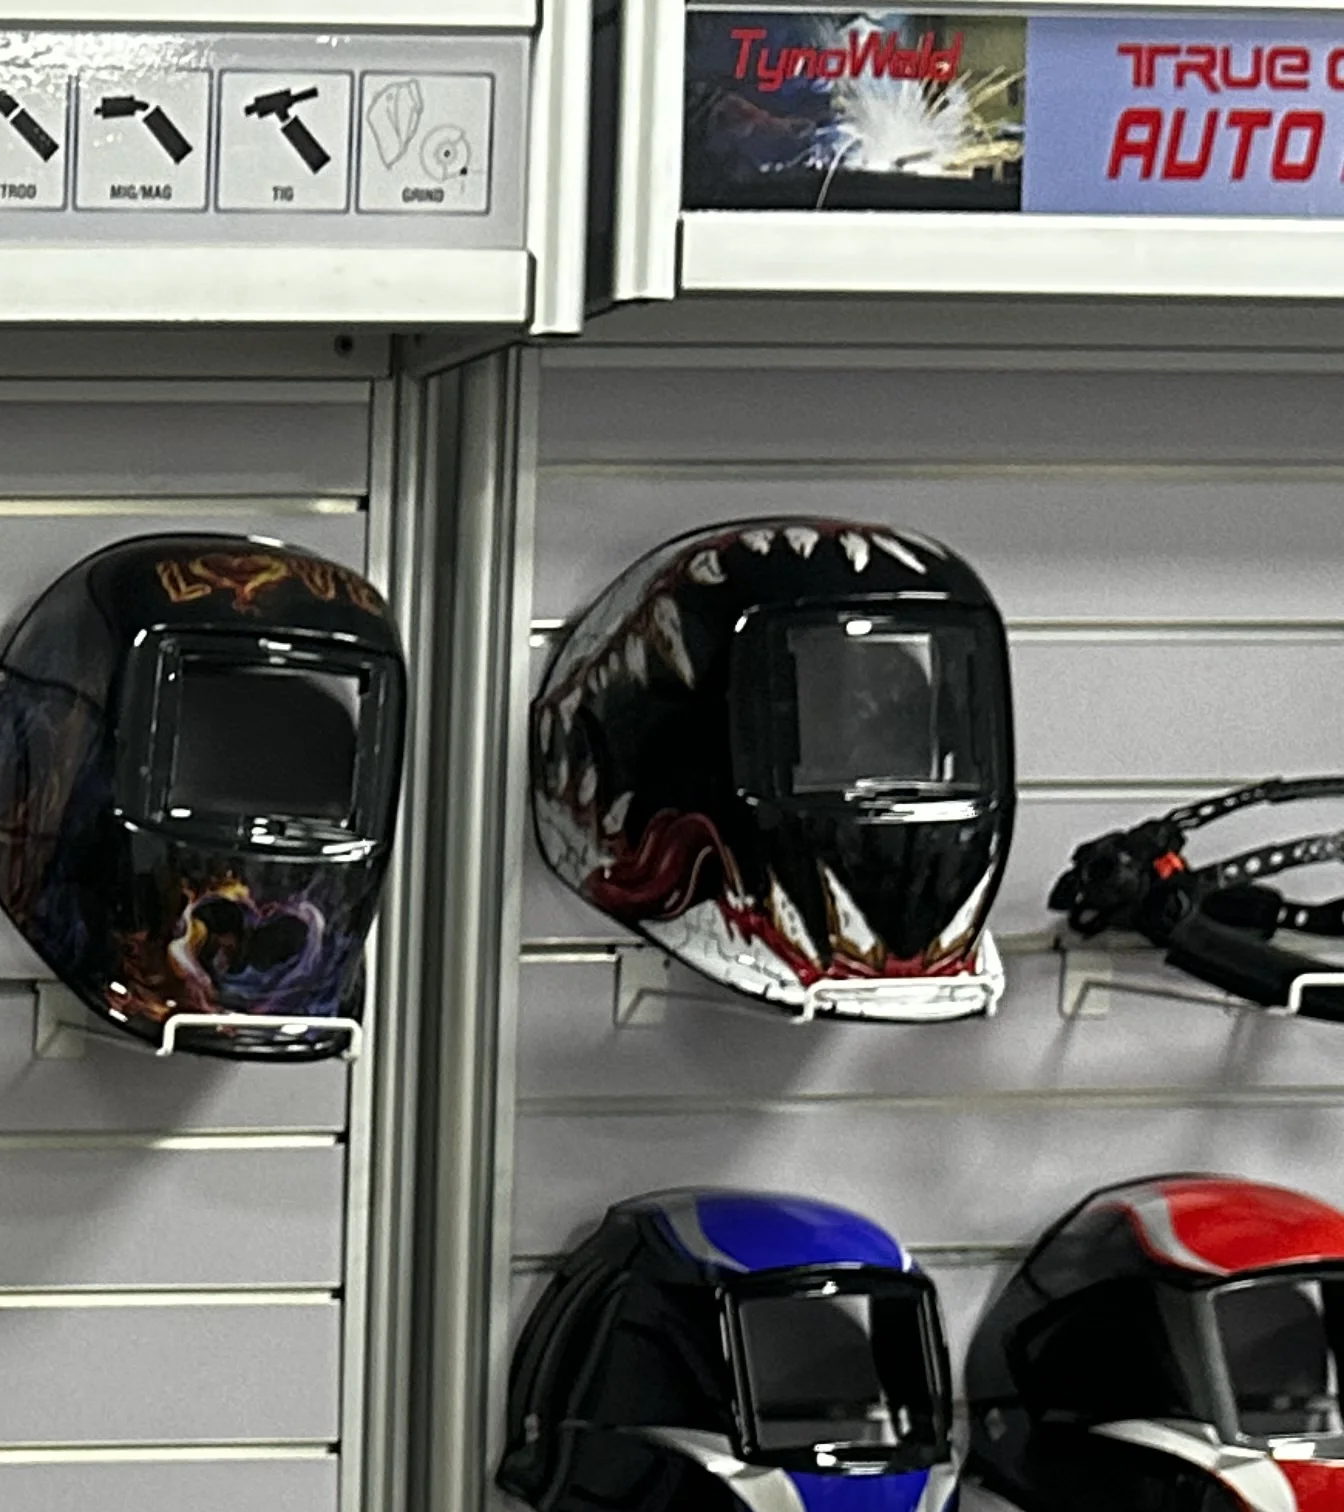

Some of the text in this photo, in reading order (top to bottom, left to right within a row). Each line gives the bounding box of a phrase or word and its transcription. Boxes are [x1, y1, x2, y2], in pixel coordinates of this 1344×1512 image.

[730, 27, 963, 91] TynoWeld
[1117, 44, 1310, 93] TRUE
[1107, 108, 1325, 181] AUTO
[272, 185, 294, 202] TIG
